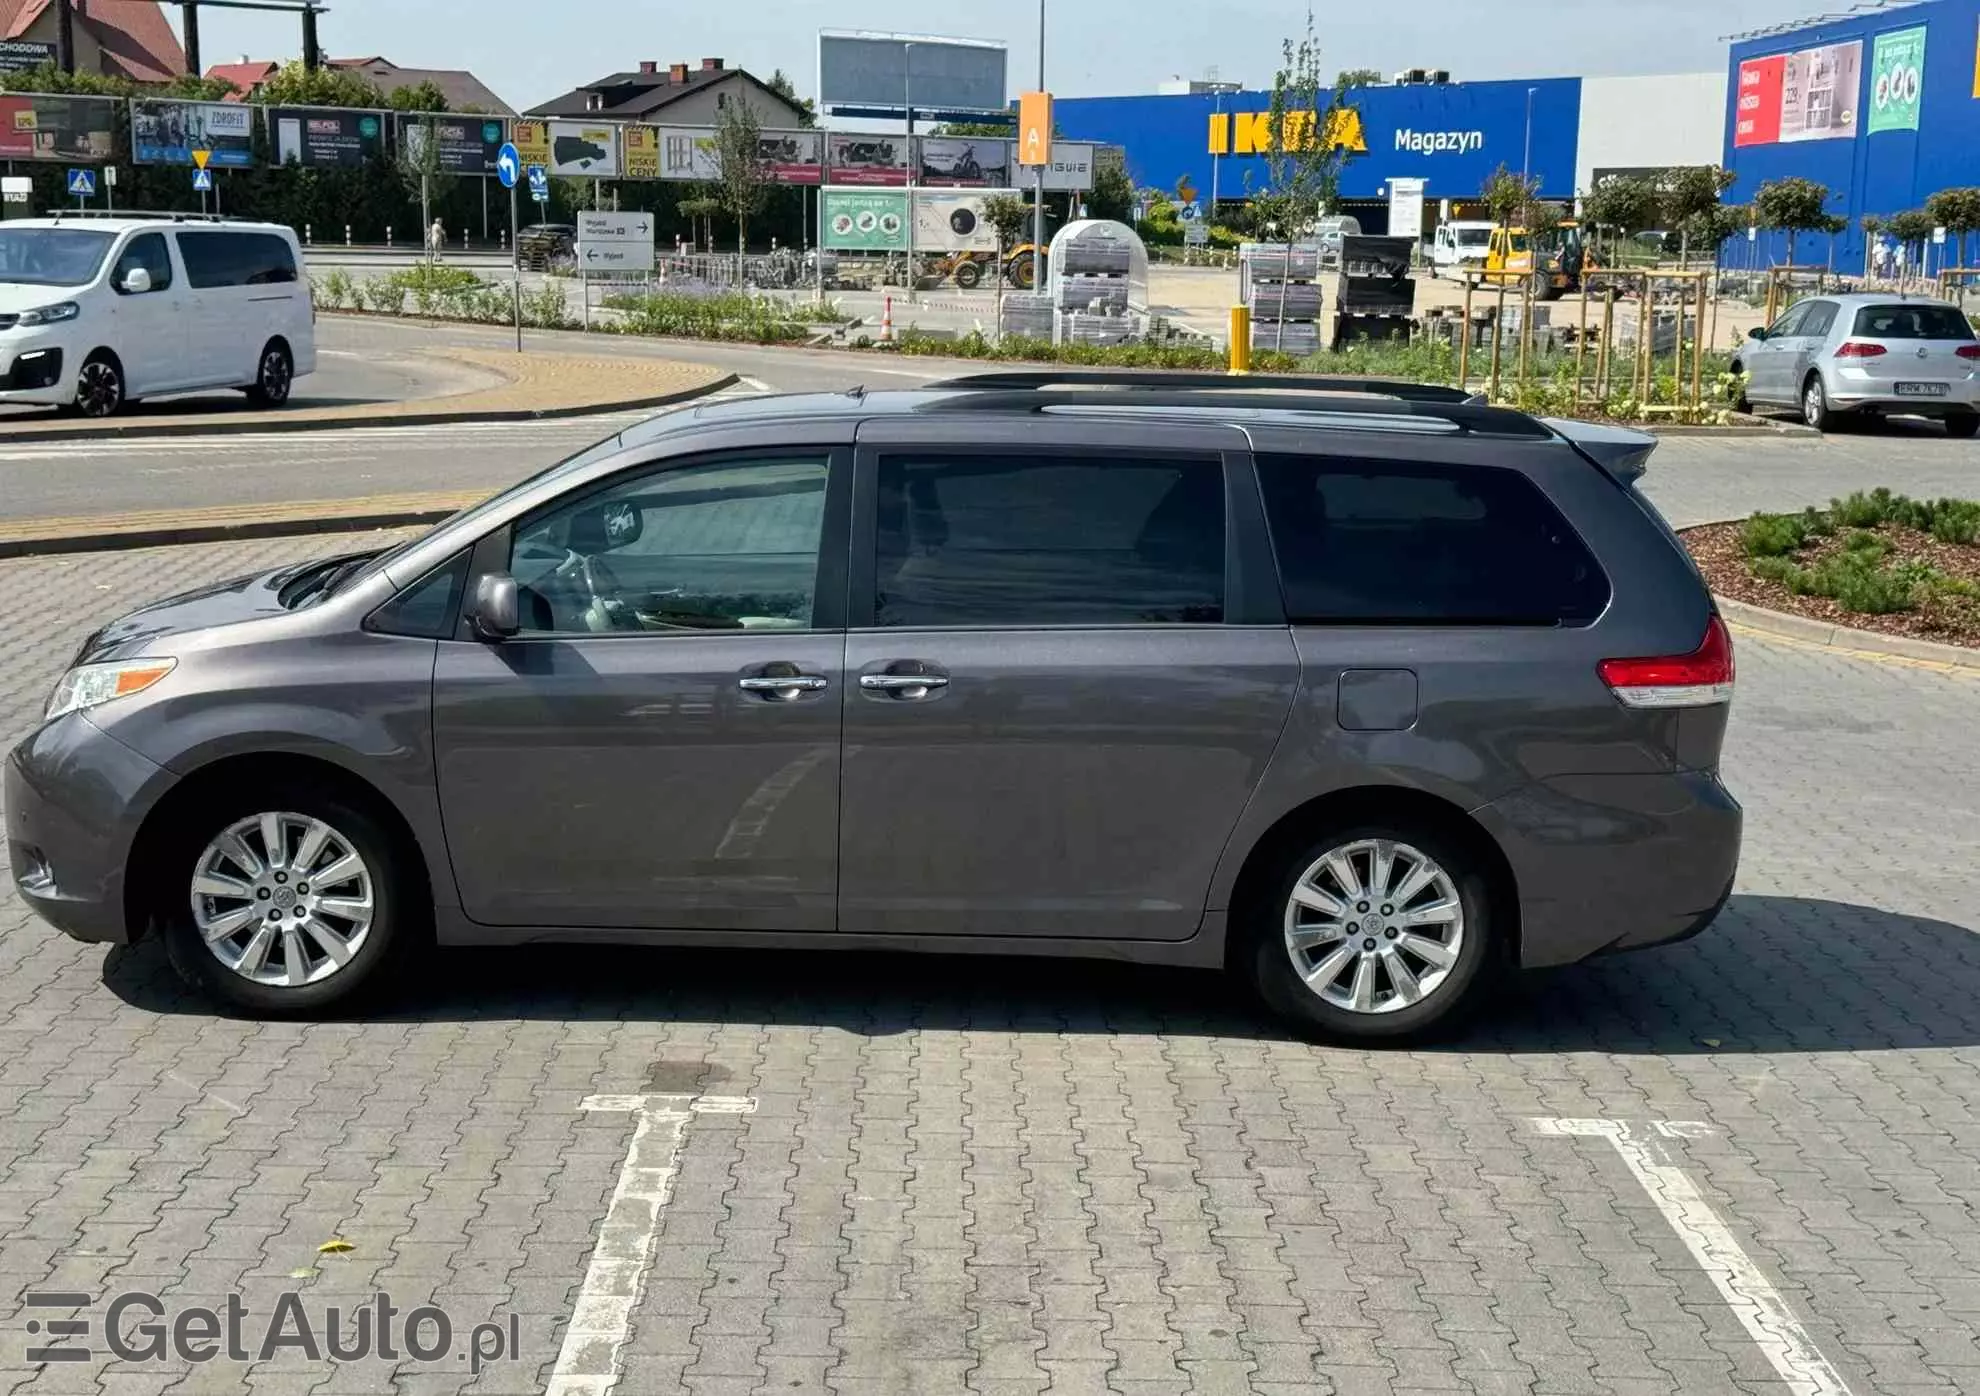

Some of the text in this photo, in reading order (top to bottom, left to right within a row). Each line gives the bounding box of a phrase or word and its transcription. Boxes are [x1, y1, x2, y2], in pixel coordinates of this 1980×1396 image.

[1027, 127, 1040, 148] A
[1395, 128, 1483, 155] Magazyn
[629, 158, 657, 168] NISKIE
[629, 167, 657, 177] CENY
